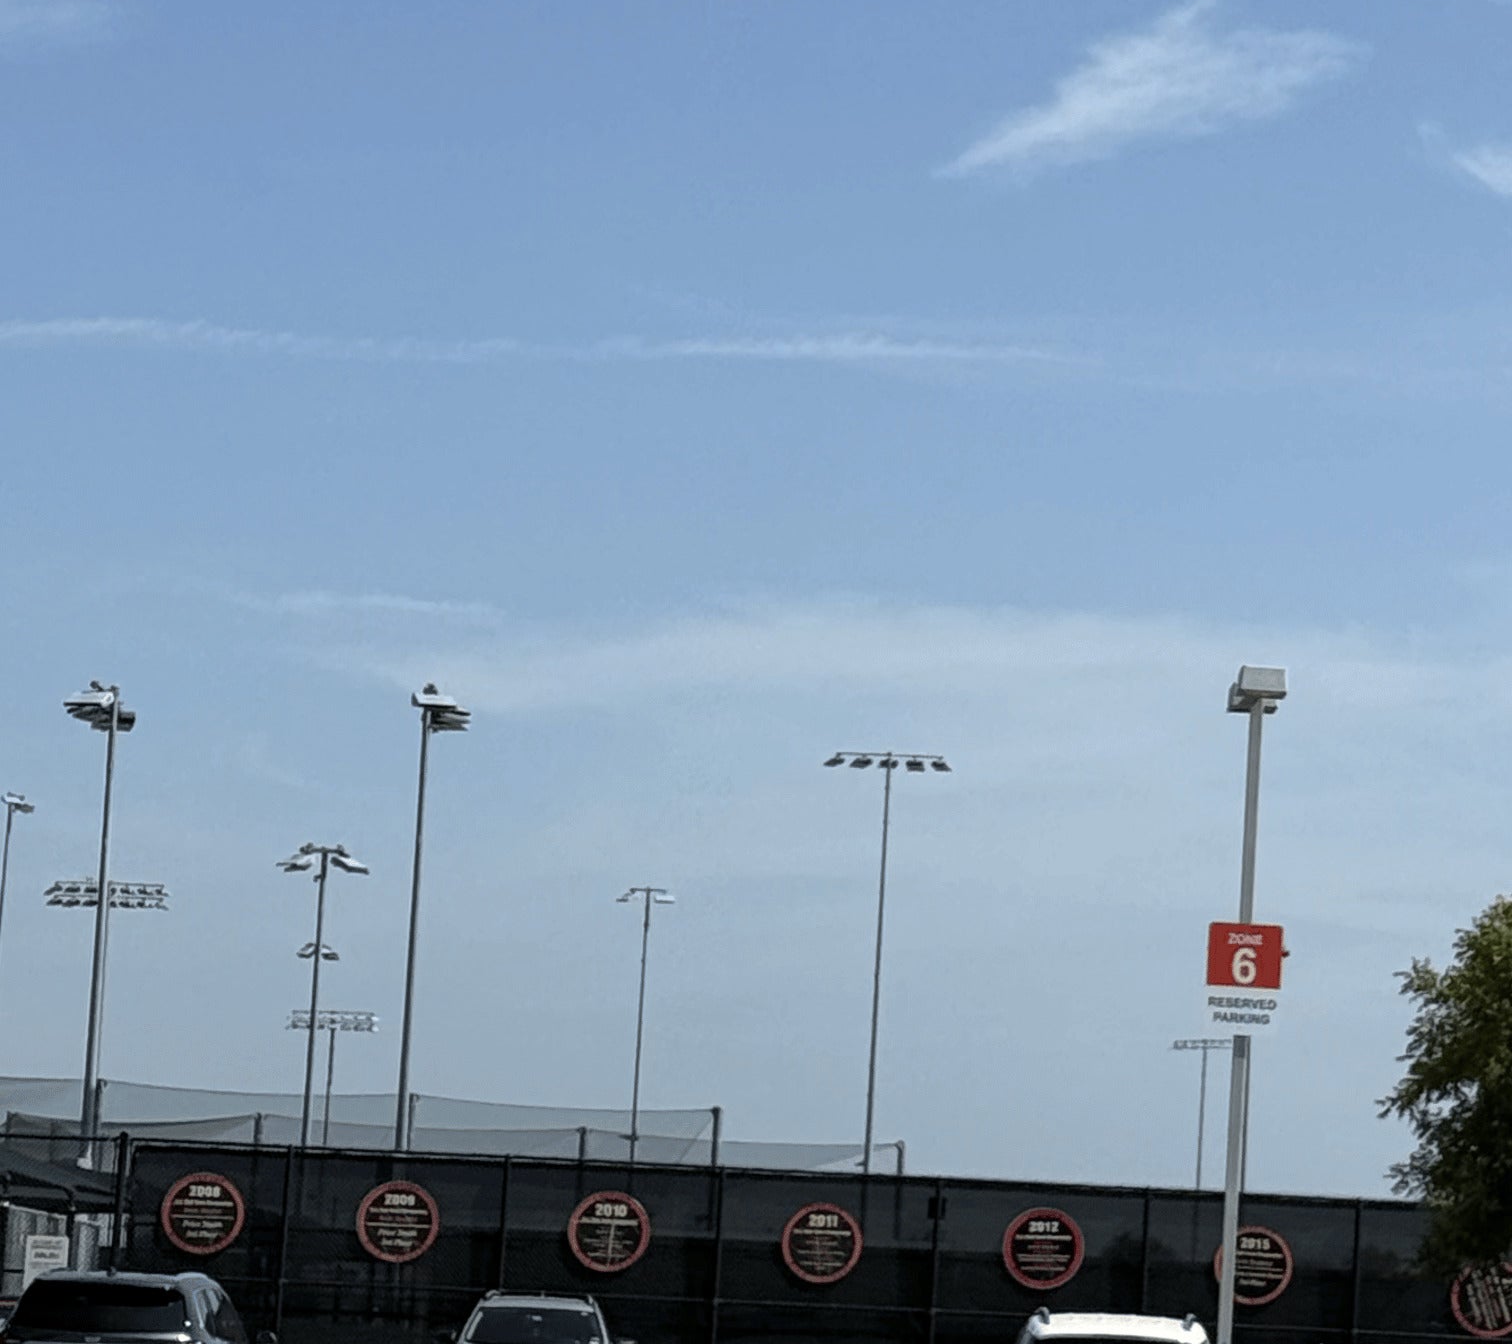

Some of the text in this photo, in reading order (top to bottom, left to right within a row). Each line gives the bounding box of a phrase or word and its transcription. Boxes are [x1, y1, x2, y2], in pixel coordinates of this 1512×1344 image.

[1228, 932, 1262, 945] ZONE
[1232, 947, 1256, 984] 6
[1207, 996, 1277, 1011] RESERVED
[1212, 1011, 1270, 1025] PARKING
[595, 1203, 628, 1217] 2010
[808, 1214, 838, 1228] 2011
[1028, 1221, 1060, 1233] 2012
